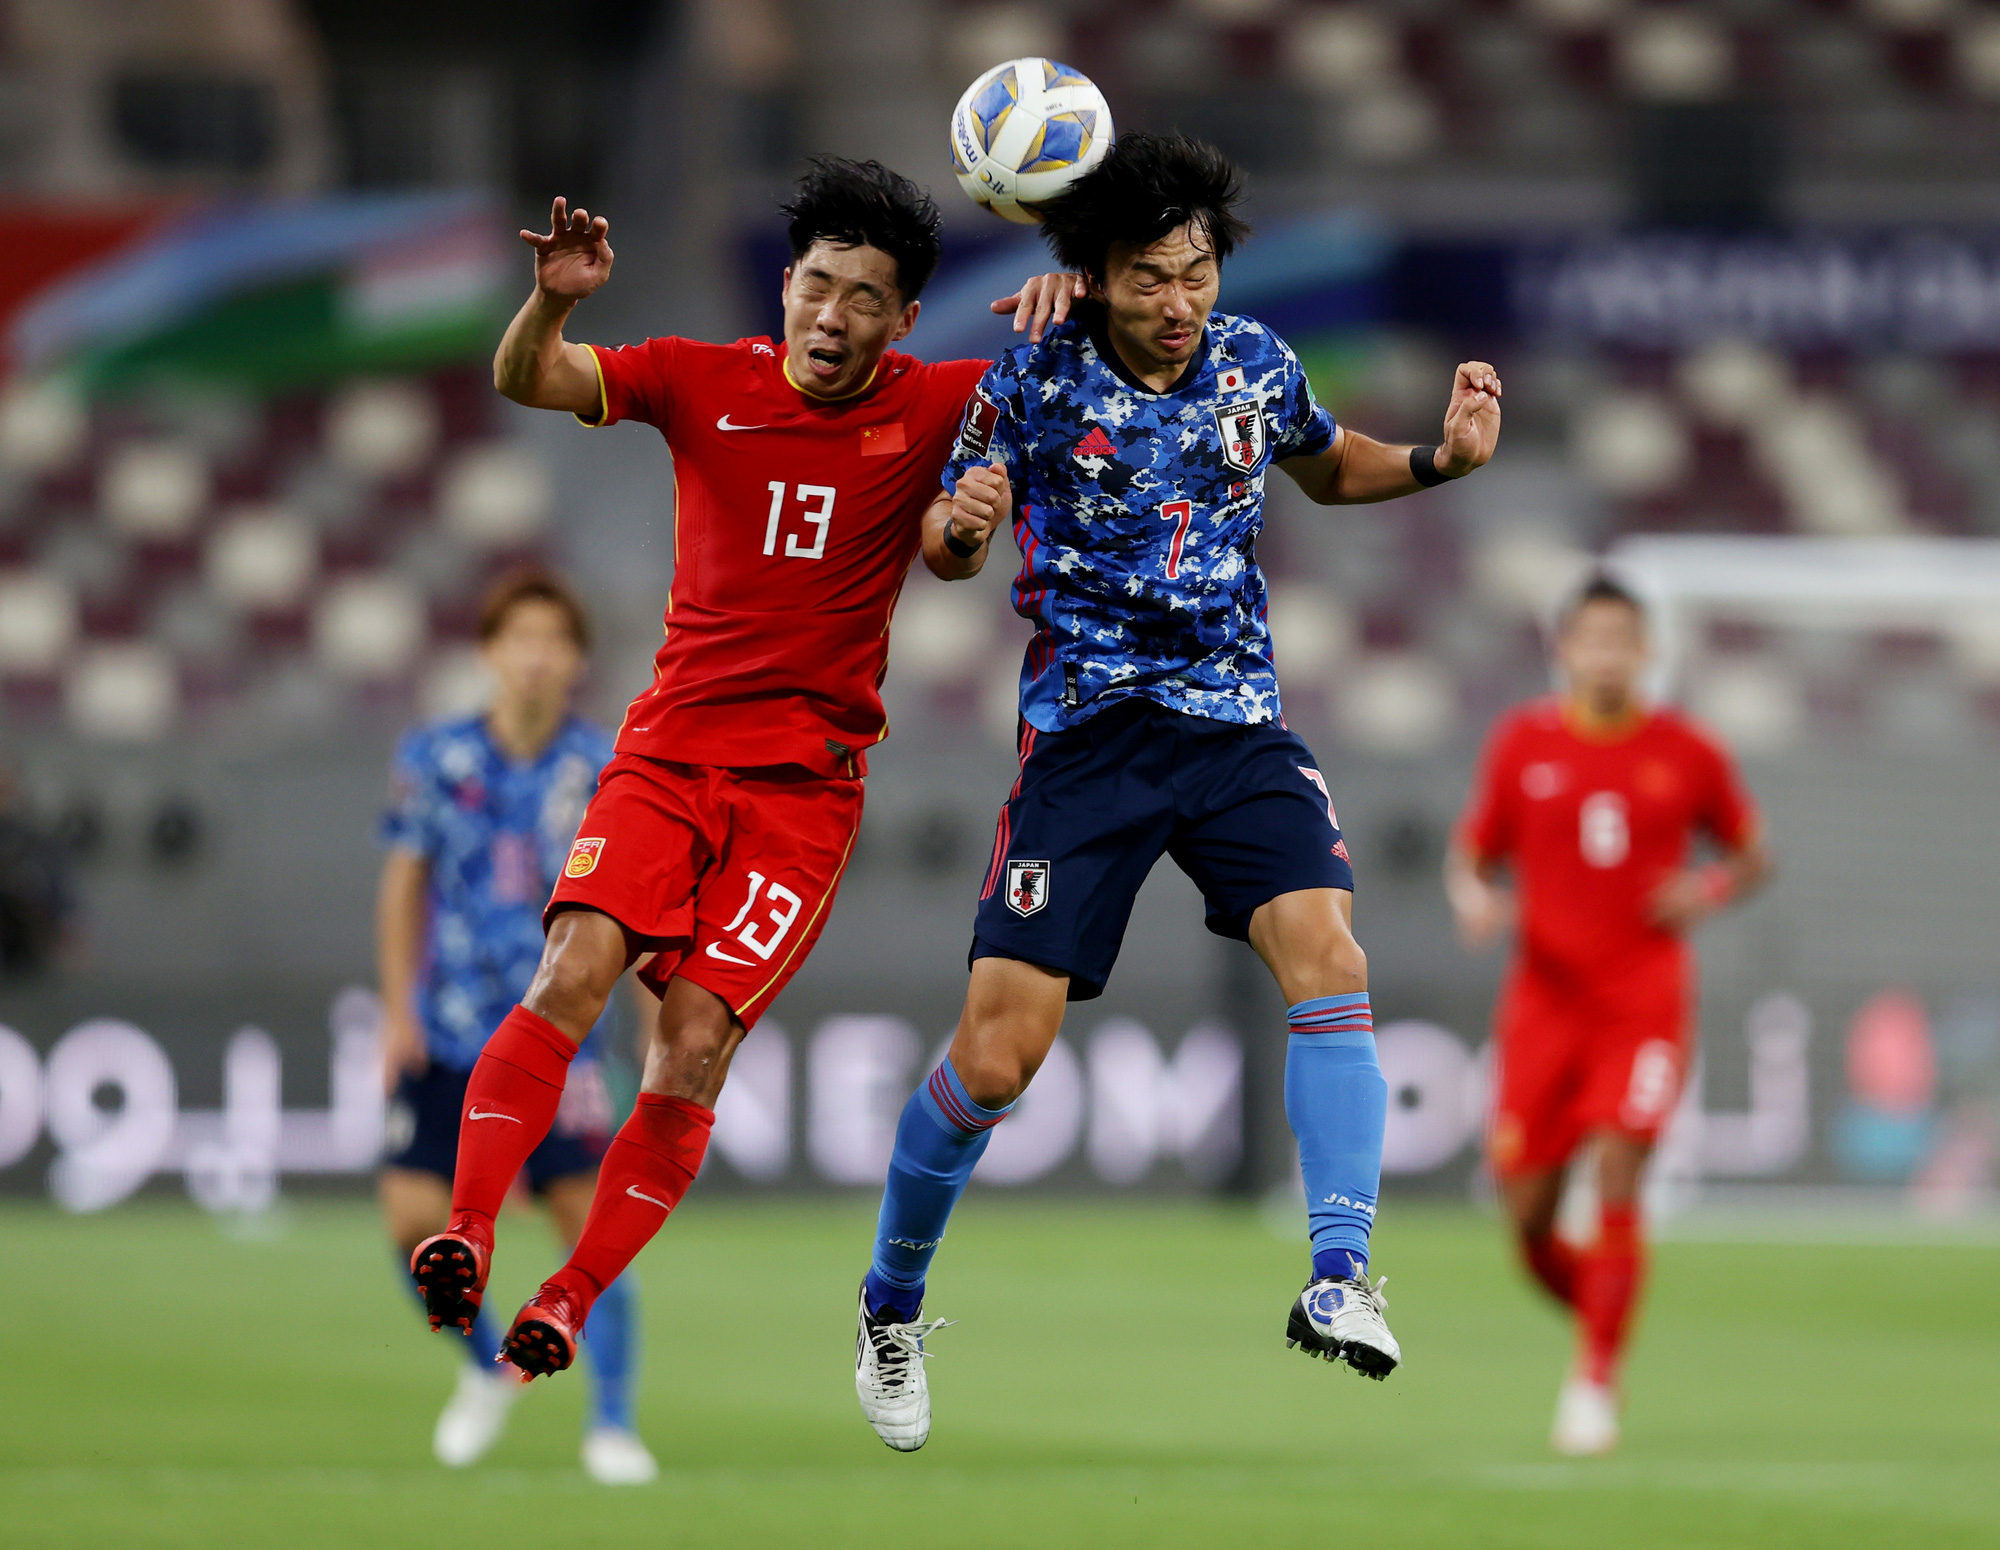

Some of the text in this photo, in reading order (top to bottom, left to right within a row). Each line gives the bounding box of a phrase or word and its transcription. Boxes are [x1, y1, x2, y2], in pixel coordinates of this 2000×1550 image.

[1227, 403, 1251, 415] JAPAN
[1073, 445, 1118, 456] adidas
[1238, 448, 1256, 462] JFA
[763, 480, 836, 560] 13
[1160, 499, 1192, 579] 7
[1297, 766, 1340, 831] 7
[576, 841, 601, 850] CFA
[1016, 897, 1036, 907] JFA
[722, 870, 803, 961] 13
[1323, 1192, 1378, 1220] JAPA
[888, 1229, 946, 1251] JAPA
